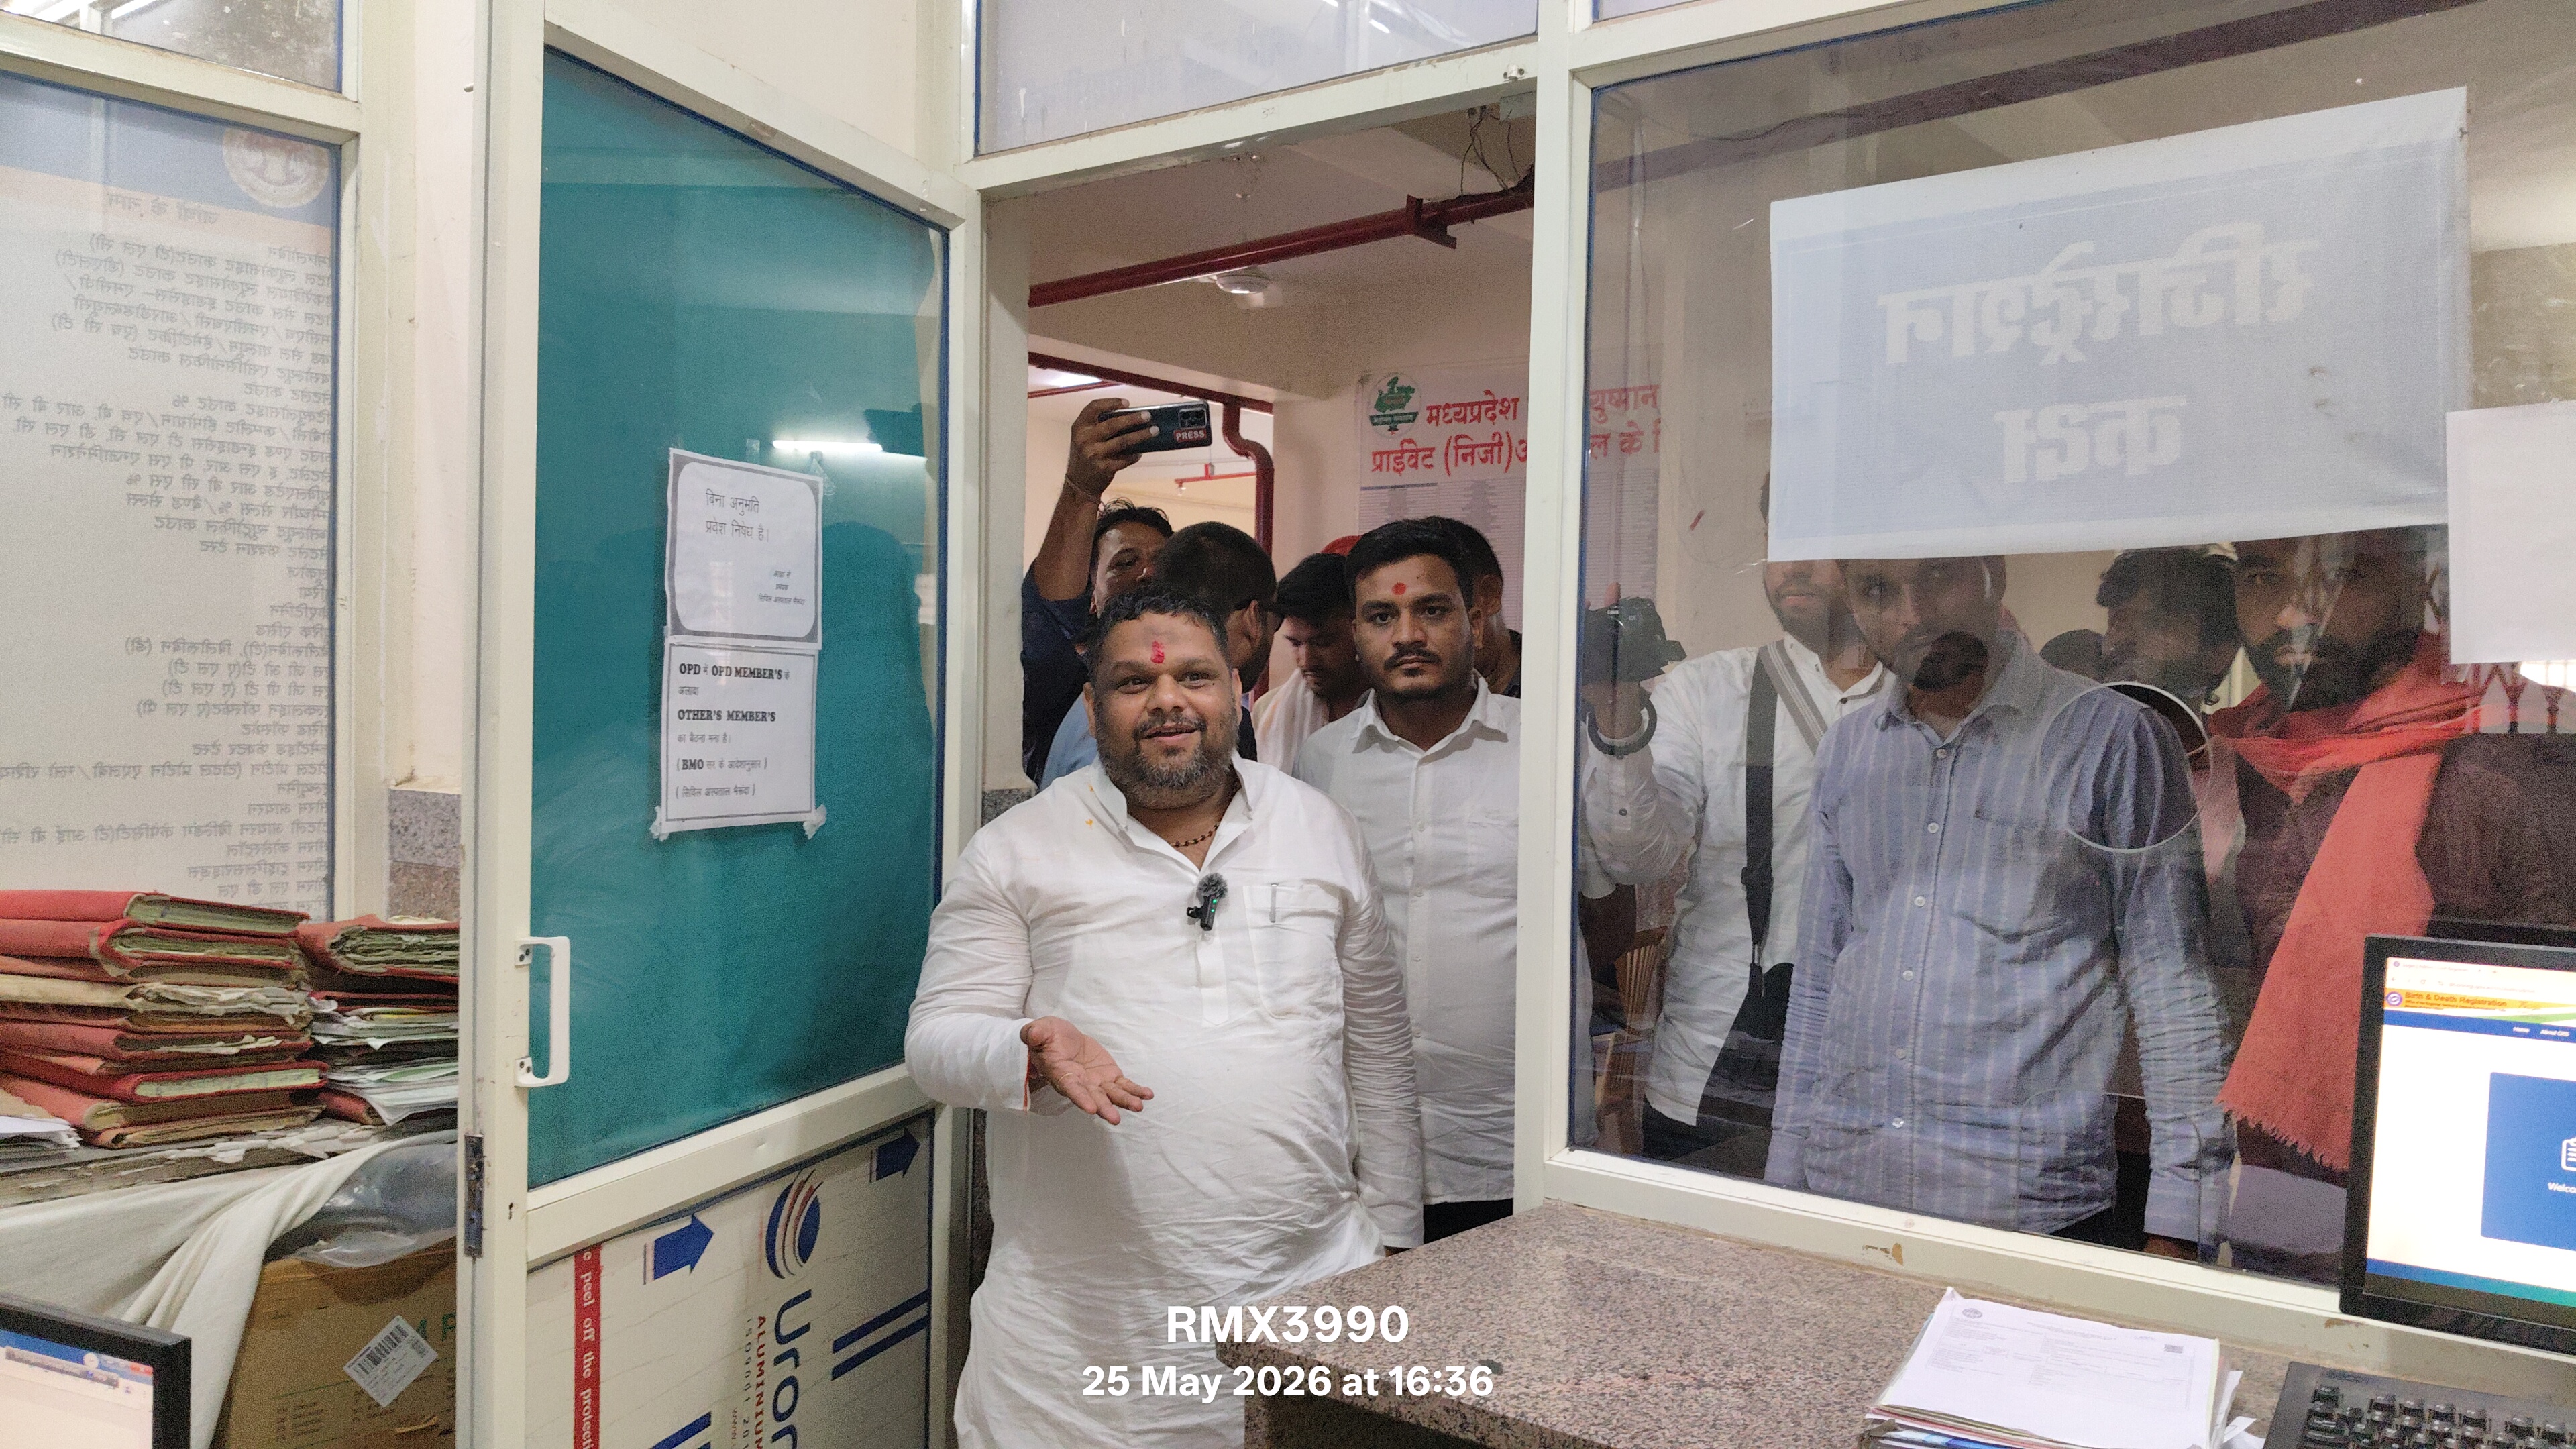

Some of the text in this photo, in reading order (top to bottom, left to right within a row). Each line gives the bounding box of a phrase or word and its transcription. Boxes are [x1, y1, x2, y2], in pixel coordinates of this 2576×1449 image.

[1426, 384, 1661, 427] मध्यप्रदेश युष्मान
[1176, 430, 1205, 441] PRESS
[706, 488, 760, 516] बिना अनुमति
[705, 516, 727, 536] प्रवेश
[731, 519, 754, 539] निषेध
[679, 663, 701, 675] OPD
[712, 665, 733, 677] OPD
[734, 666, 783, 680] MEMBER'S
[678, 709, 776, 722] OTHER'S MEMBER'S
[2434, 994, 2457, 1002] Death
[2459, 997, 2508, 1007] Registration
[580, 1271, 594, 1308] peel
[582, 1318, 595, 1342] off
[581, 1350, 594, 1379] the
